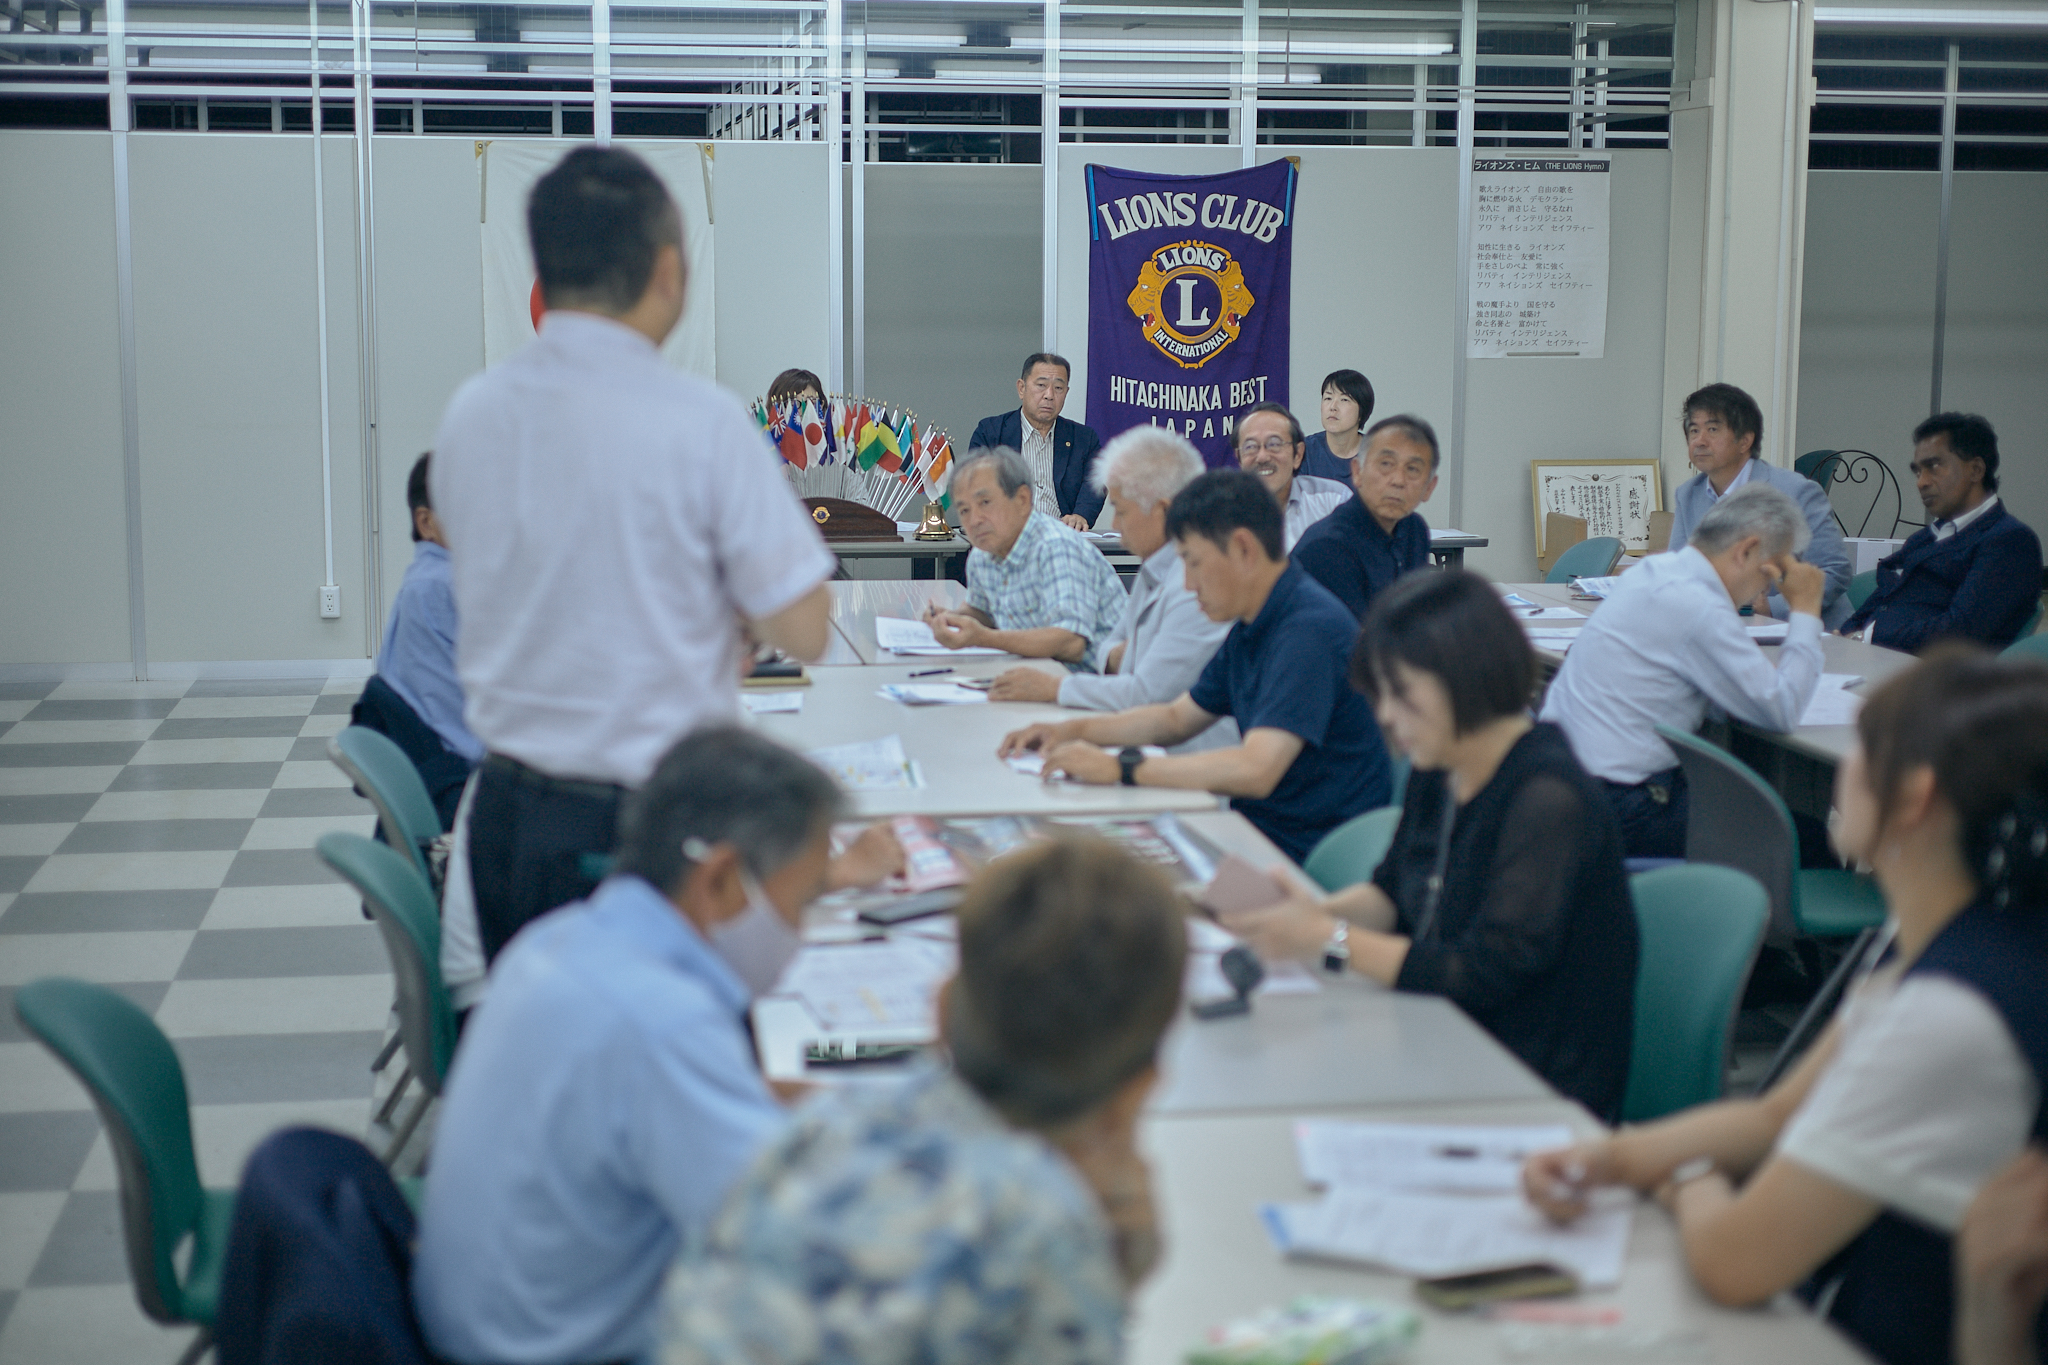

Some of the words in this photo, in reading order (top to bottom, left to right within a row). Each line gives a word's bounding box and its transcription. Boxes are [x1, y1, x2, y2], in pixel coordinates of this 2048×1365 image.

[1474, 161, 1540, 171] ライオンズ・ヒム
[1479, 195, 1522, 203] 胸に燃ゆる火
[1530, 195, 1573, 203] デモクラシー
[1098, 192, 1196, 240] LIONS
[1201, 194, 1285, 243] CLUB
[1479, 214, 1506, 222] リバティ
[1515, 214, 1572, 222] インテリジェンス
[1158, 248, 1225, 271] LIONS
[1176, 279, 1210, 326] L
[1476, 310, 1512, 318] 強き同志の
[1154, 328, 1229, 358] INTERNATIONAL
[1511, 329, 1567, 337] インテリジェンス
[1110, 376, 1222, 412] HITACHINAKA
[1230, 376, 1268, 408] BEST
[1629, 488, 1641, 519] 感謝状
